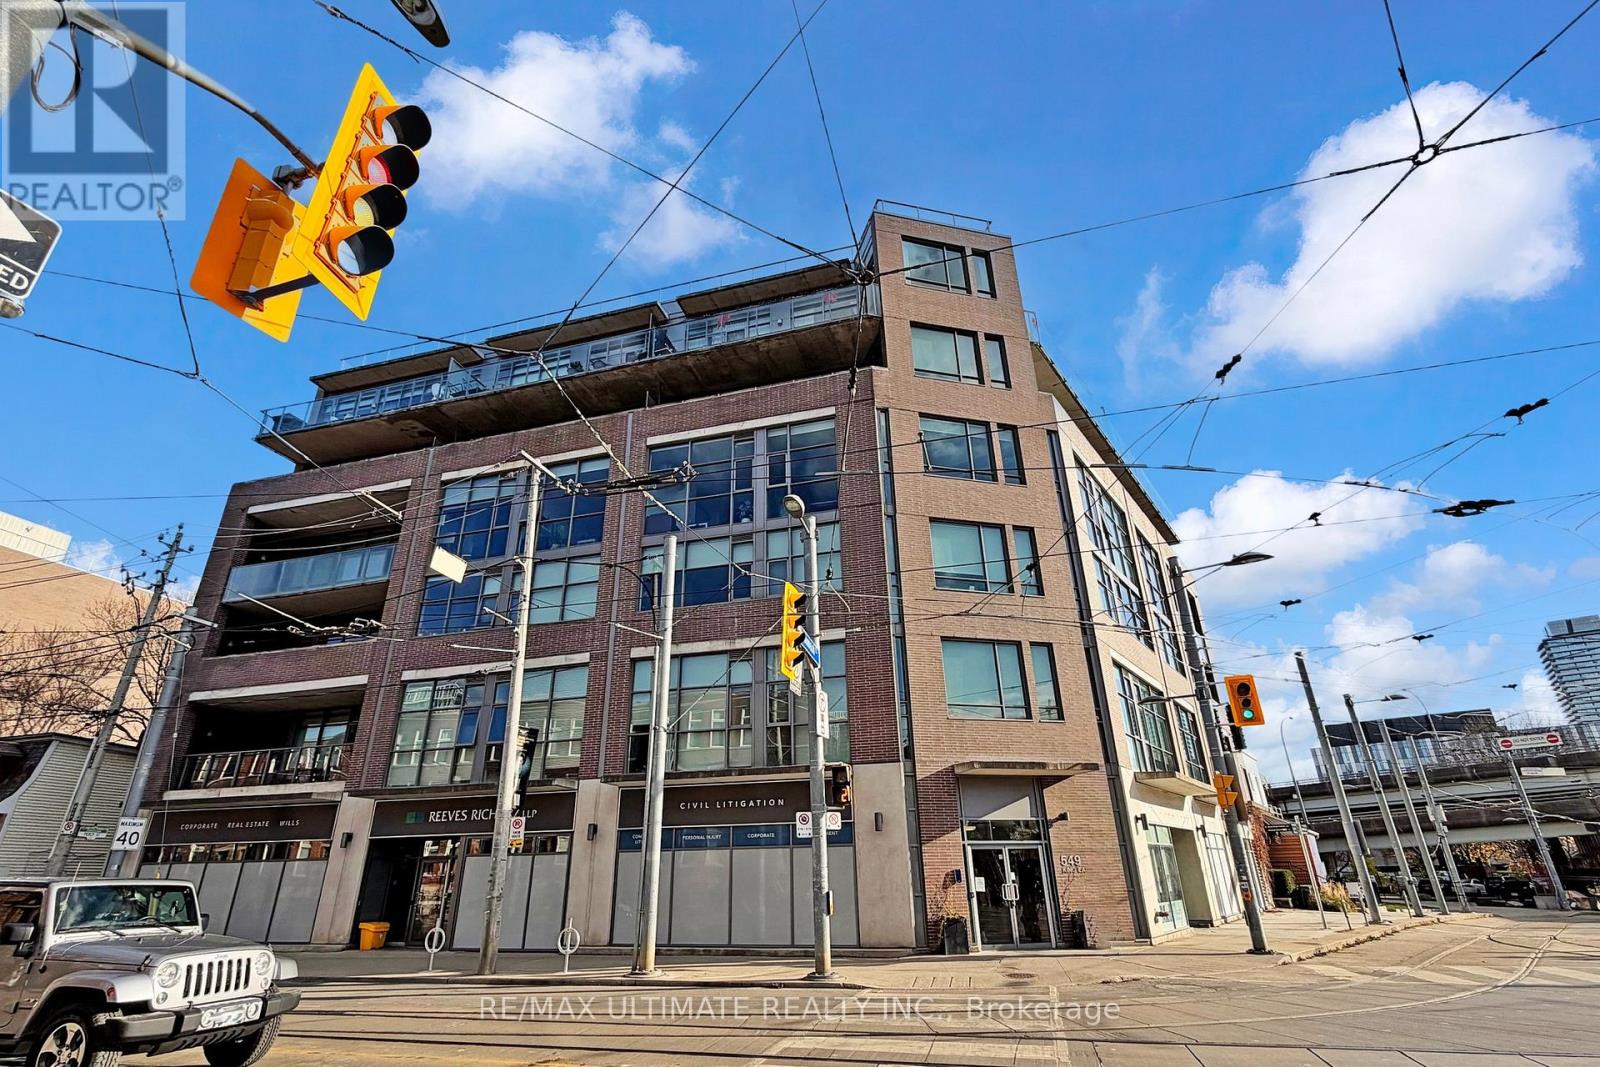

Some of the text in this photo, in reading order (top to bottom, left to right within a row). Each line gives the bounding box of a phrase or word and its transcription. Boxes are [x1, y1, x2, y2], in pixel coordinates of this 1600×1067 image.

[679, 798, 785, 810] CIVIL LITIGATION
[428, 809, 468, 822] REEVES
[245, 820, 270, 828] ESTATE
[279, 819, 300, 827] WILLS
[116, 831, 140, 846] 40
[1060, 855, 1081, 867] 549
